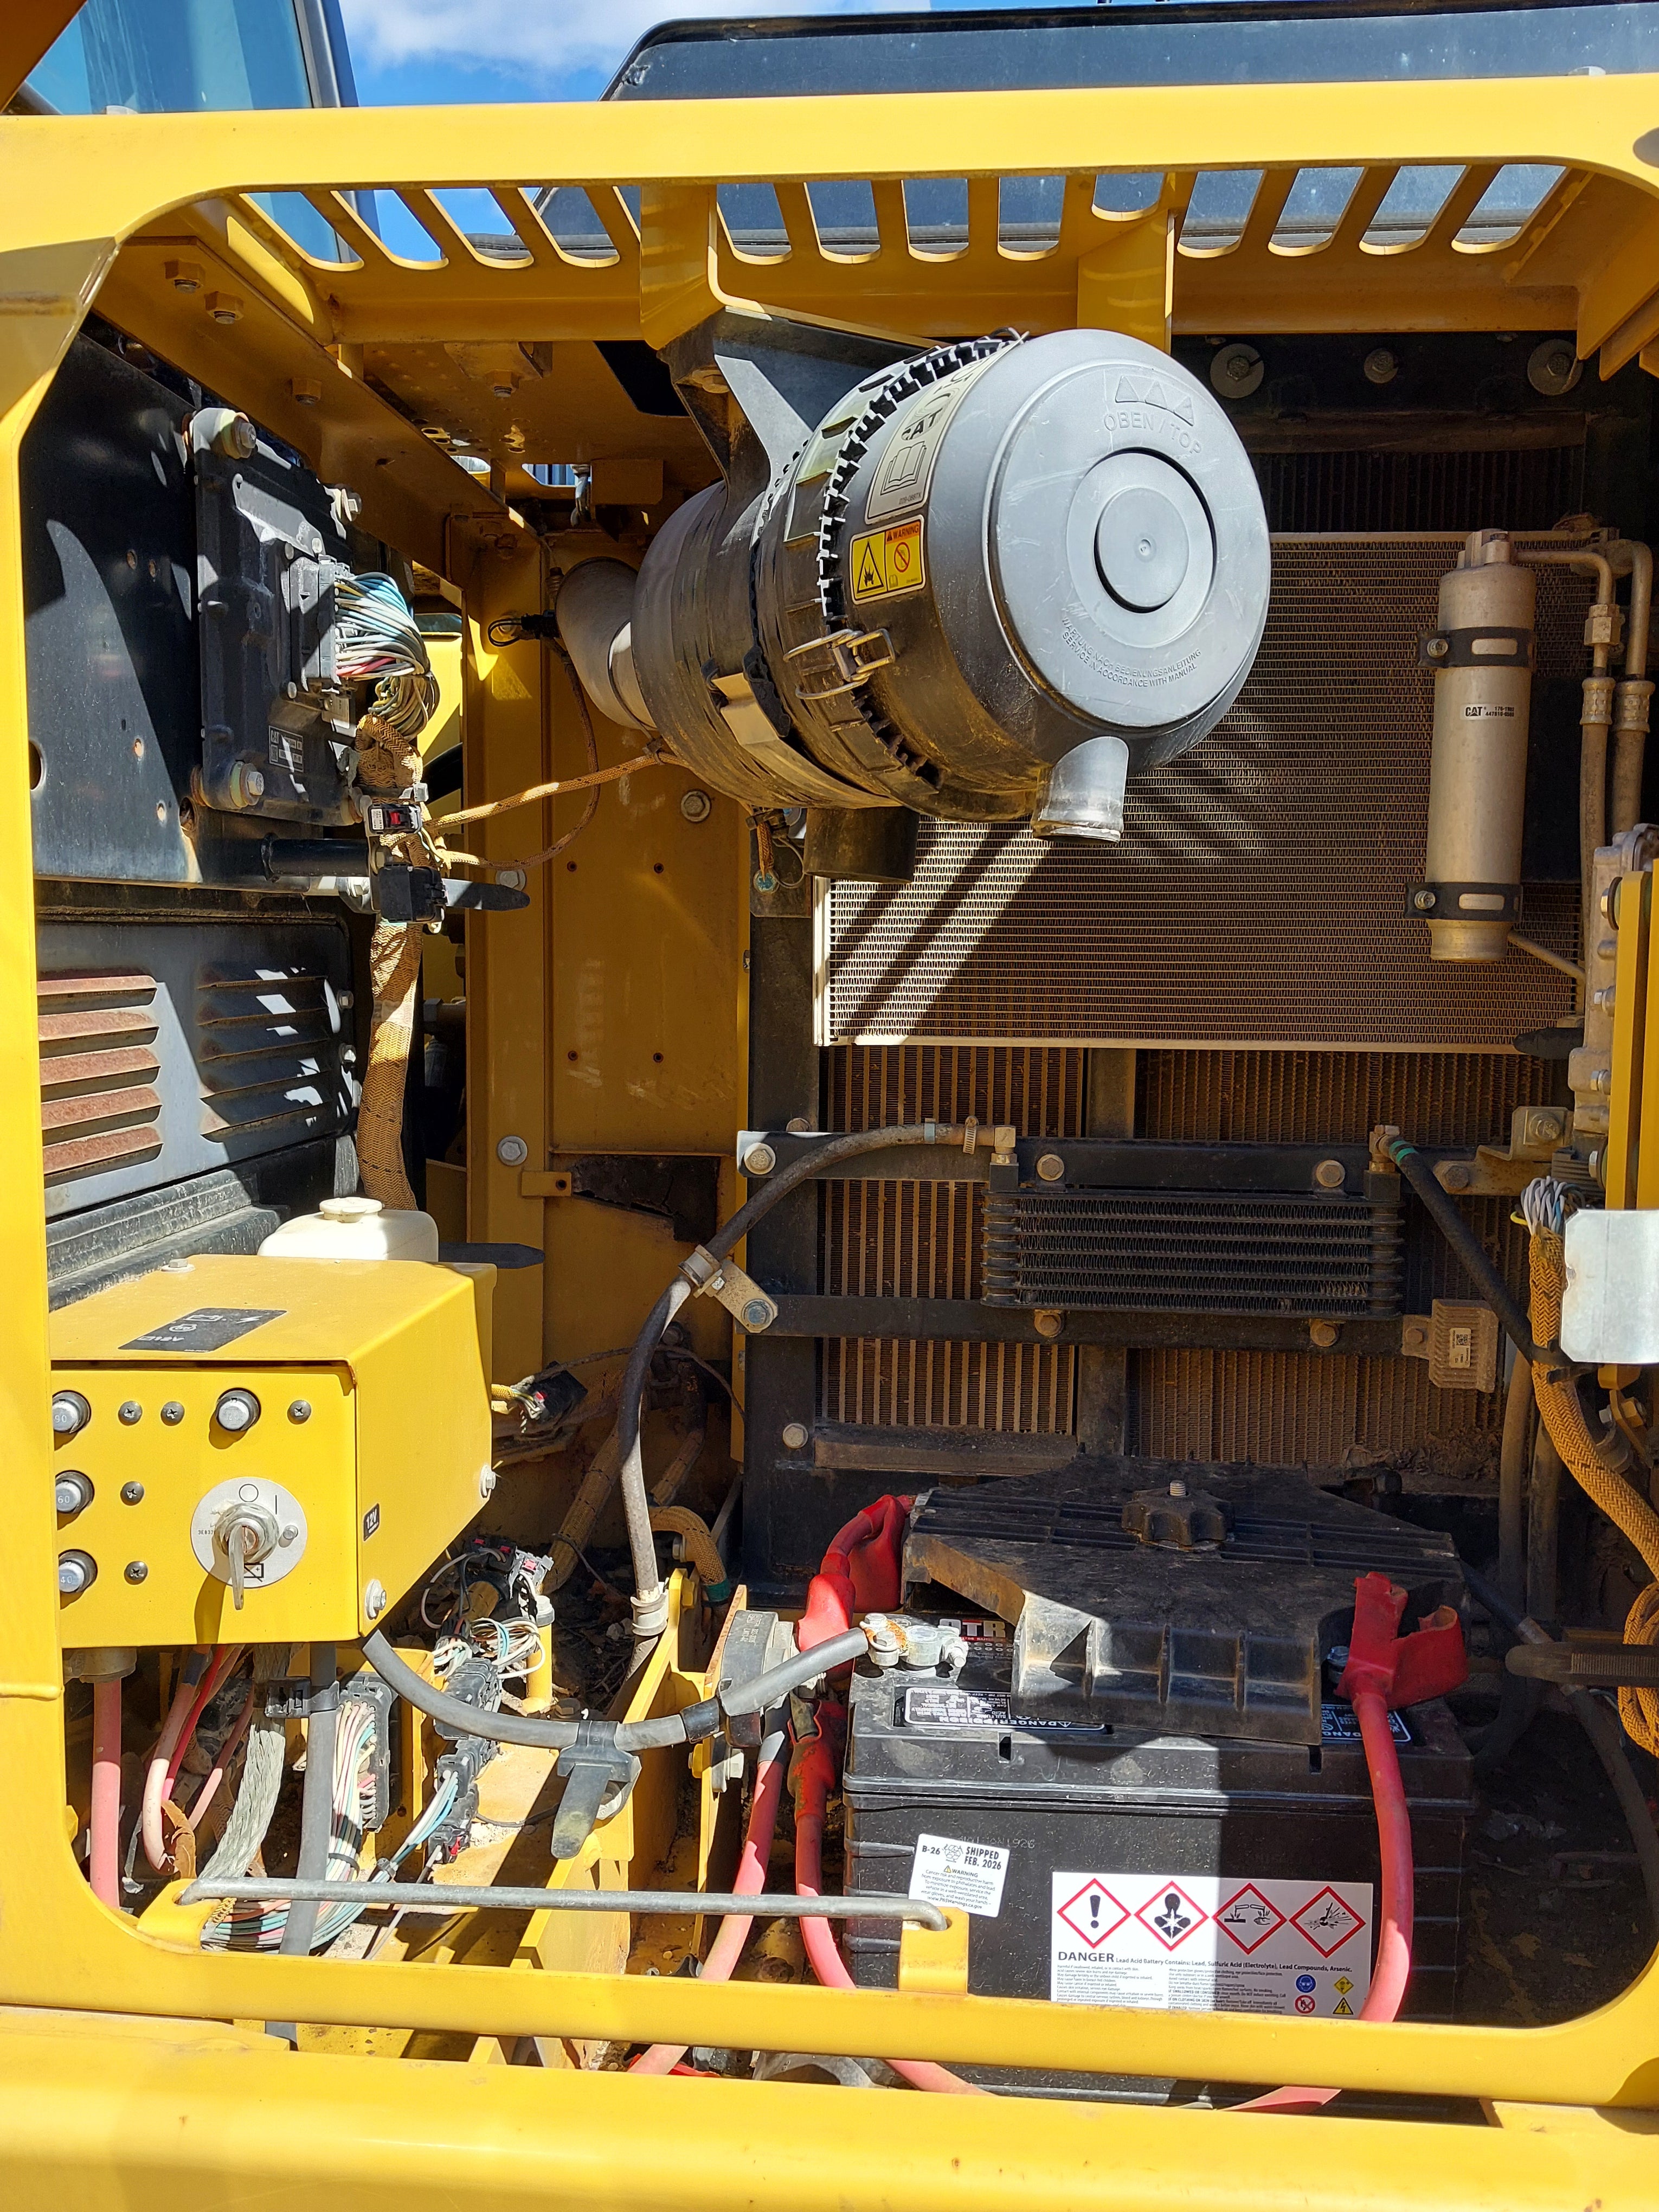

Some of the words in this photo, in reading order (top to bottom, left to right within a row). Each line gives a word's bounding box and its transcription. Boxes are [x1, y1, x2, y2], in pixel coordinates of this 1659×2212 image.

[901, 408, 943, 440] CAT
[1104, 411, 1153, 431] OBEN
[1171, 423, 1201, 454] TOP
[892, 524, 919, 539] WARNING
[1062, 631, 1089, 664] SERVICE
[1097, 666, 1148, 687] ACCORDANCE
[1149, 676, 1167, 687] WITH
[1168, 663, 1198, 683] MANUAL
[1115, 650, 1201, 678] BEDIENUNGSANLEITUNG
[1465, 707, 1482, 717] CAT
[55, 1414, 67, 1423] 90
[58, 1495, 70, 1504] 60
[366, 1508, 377, 1529] 12V
[60, 1576, 73, 1584] 40
[922, 1845, 941, 1855] B-26
[966, 1846, 999, 1860] SHIPPED
[964, 1856, 979, 1867] FEB.
[982, 1859, 1002, 1870] 2026
[952, 1868, 978, 1877] WARNING
[1058, 1951, 1114, 1962] DANGER
